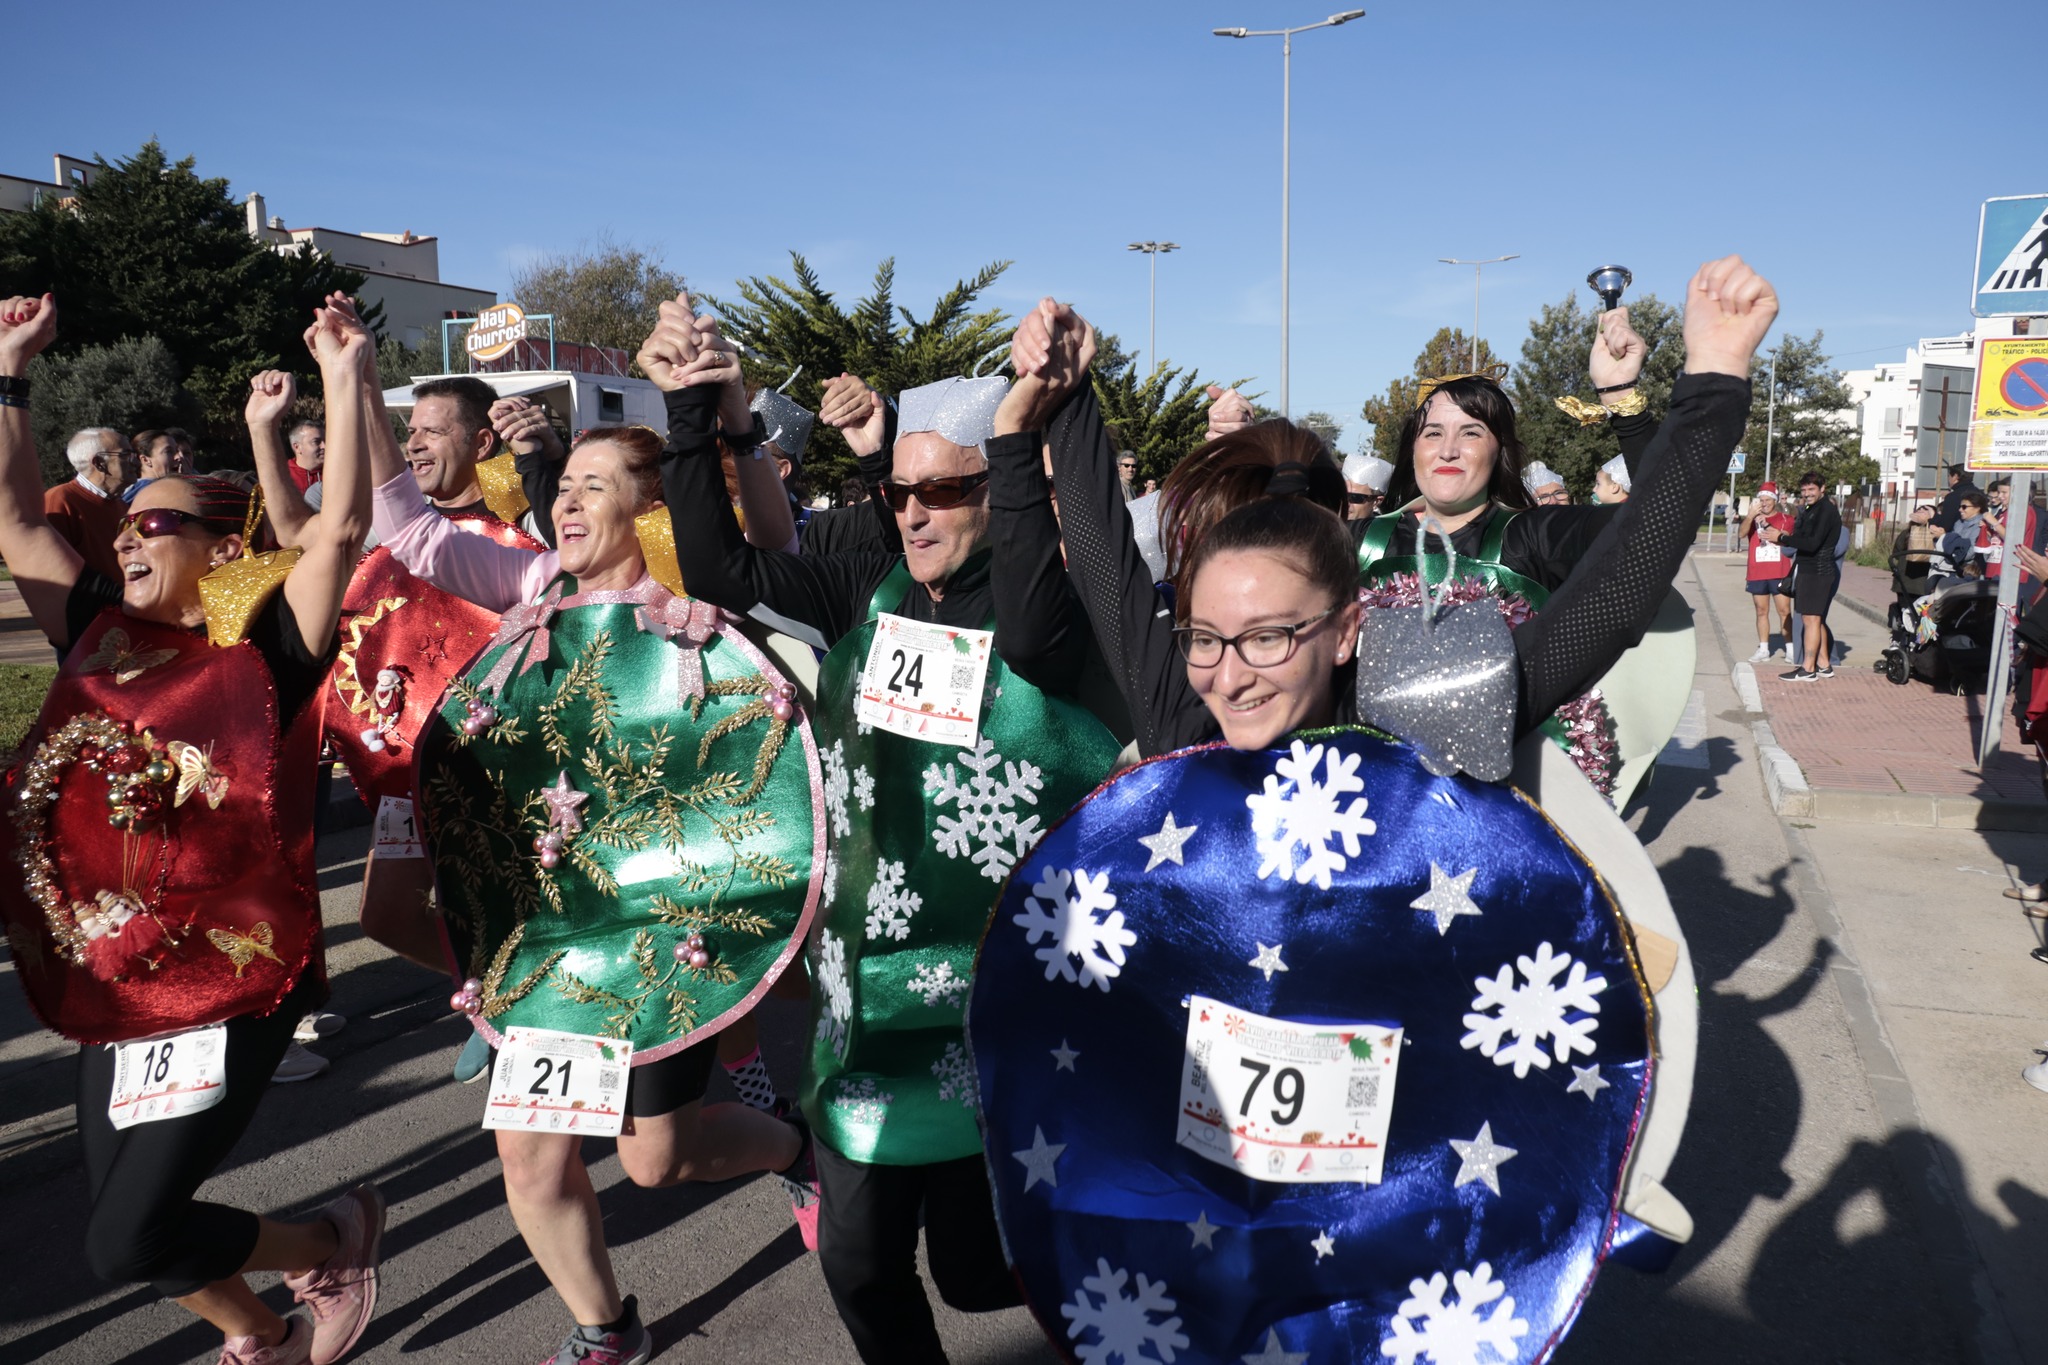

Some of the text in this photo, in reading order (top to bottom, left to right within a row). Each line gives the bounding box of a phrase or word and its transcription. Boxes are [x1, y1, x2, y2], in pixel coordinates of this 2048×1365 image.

[467, 320, 526, 352] Churros!
[480, 309, 506, 330] Hay
[868, 641, 880, 678] ANTONIO
[887, 648, 923, 697] 24
[956, 697, 961, 706] S
[117, 1048, 126, 1093] MONTSERR
[144, 1042, 174, 1086] 18
[500, 1057, 510, 1082] JUANA
[528, 1057, 572, 1097] 21
[1191, 1039, 1206, 1087] BEATRIZ
[1239, 1056, 1305, 1126] 79
[1355, 1119, 1360, 1130] L
